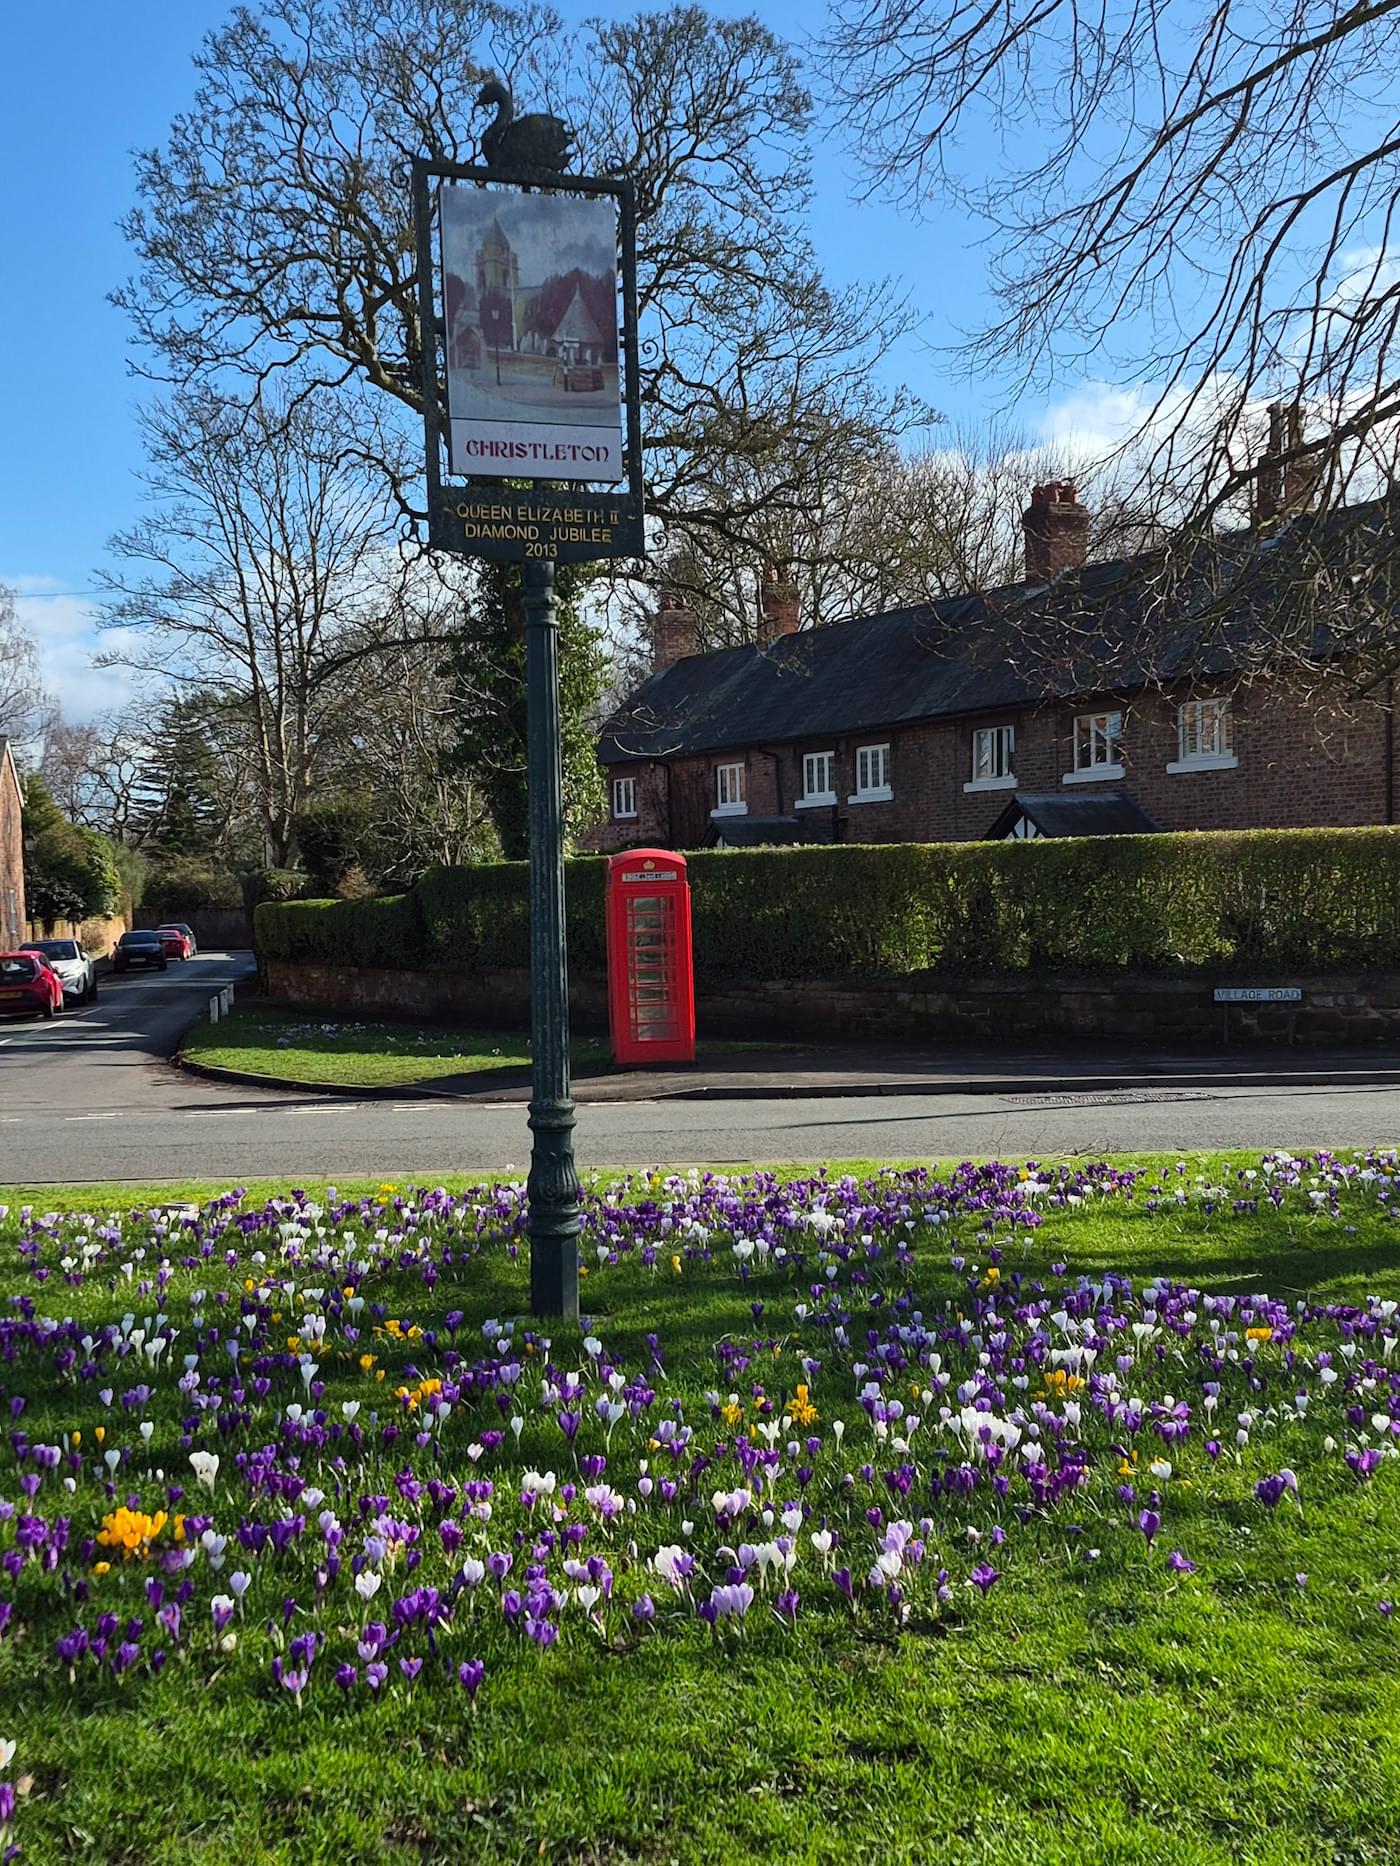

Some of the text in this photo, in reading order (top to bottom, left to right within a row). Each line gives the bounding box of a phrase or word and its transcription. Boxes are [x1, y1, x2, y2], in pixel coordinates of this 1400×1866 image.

[466, 439, 609, 462] CHRISTLETON
[457, 503, 620, 525] QUEEN ELIZABETH II
[465, 523, 612, 544] DIAMOND JUBILEE
[525, 542, 558, 558] 2013
[1269, 990, 1300, 1000] ROAD
